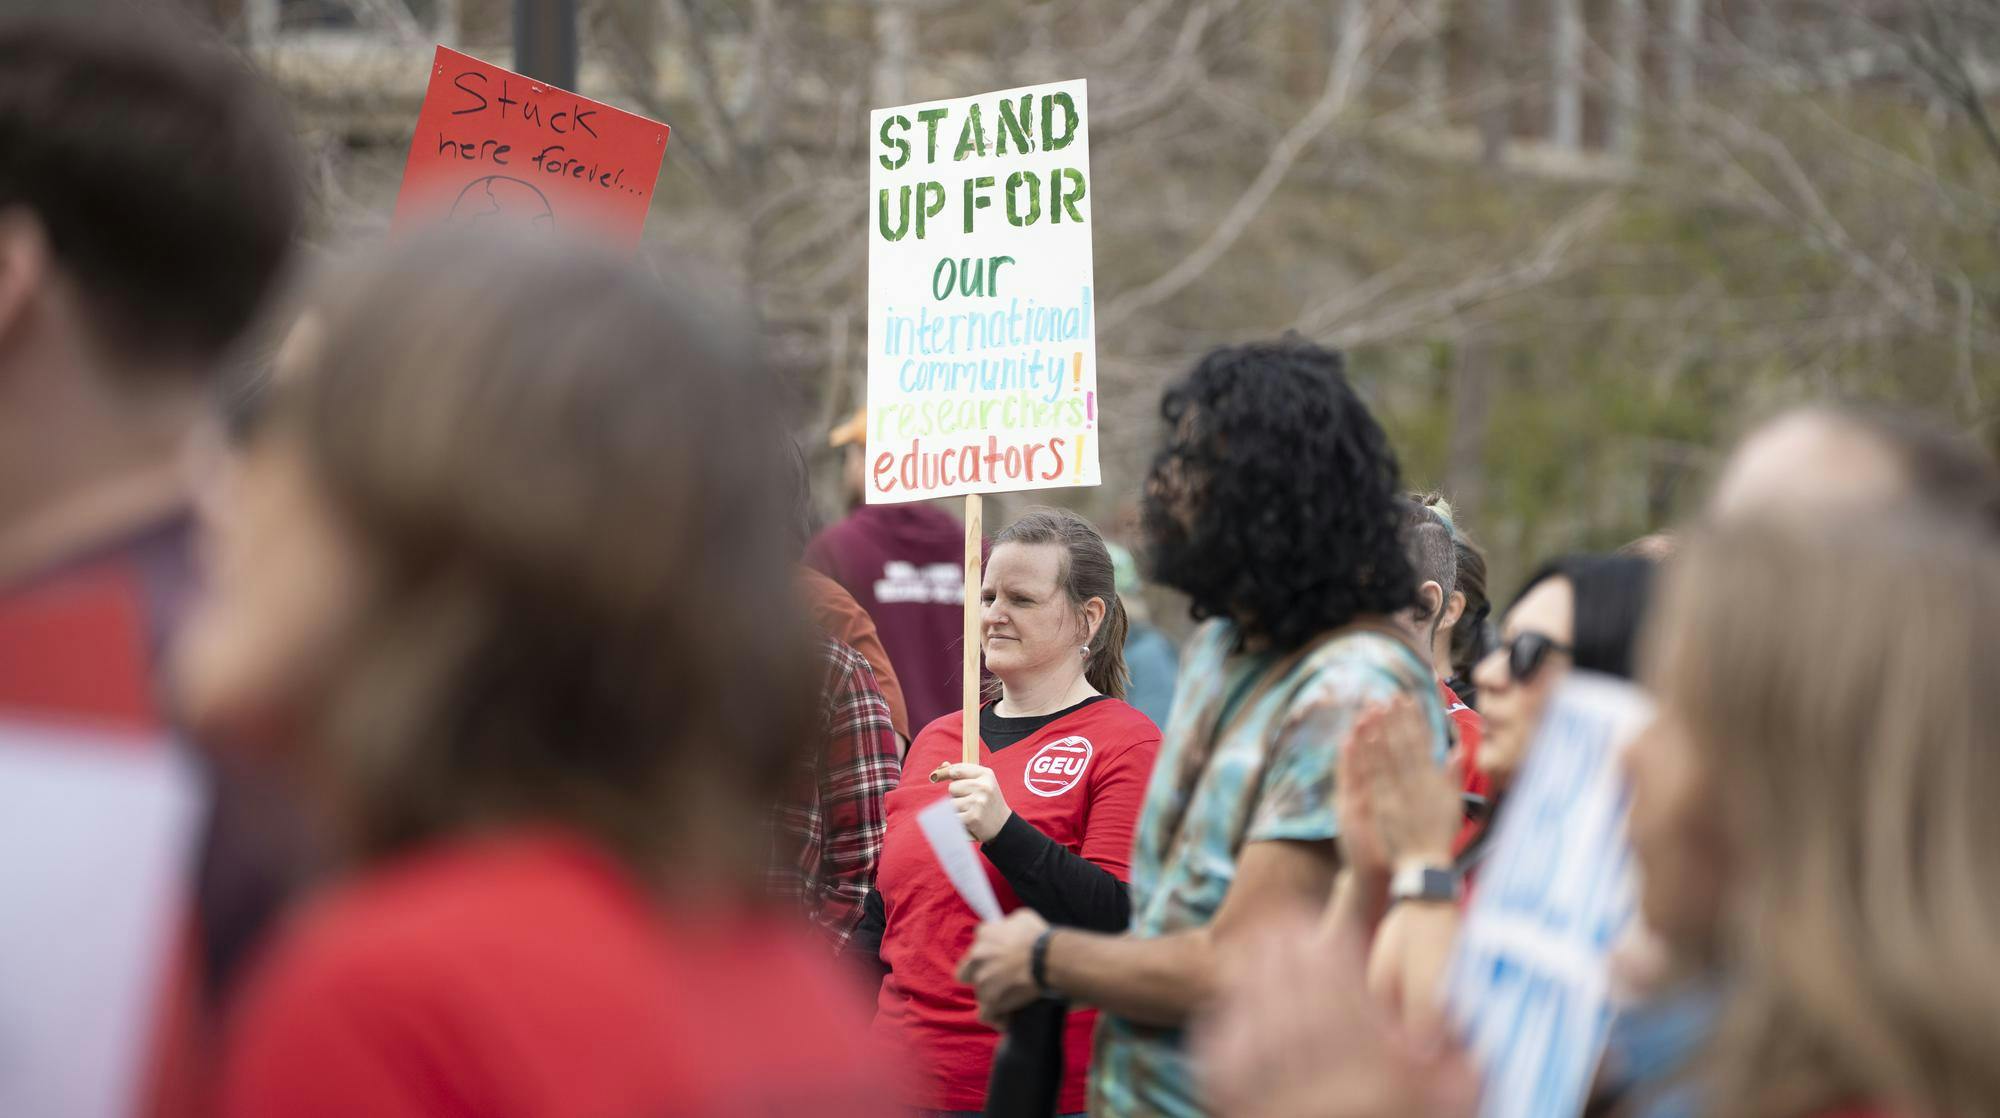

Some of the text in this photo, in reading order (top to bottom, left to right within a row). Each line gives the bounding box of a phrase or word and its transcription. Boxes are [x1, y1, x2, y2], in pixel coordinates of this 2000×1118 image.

[452, 72, 598, 138] Stuck
[879, 91, 1079, 170] STAND
[439, 132, 511, 164] here
[879, 168, 1086, 242] UP FOR
[932, 255, 1016, 301] our
[884, 286, 1092, 356] international
[1033, 756, 1085, 775] GEU
